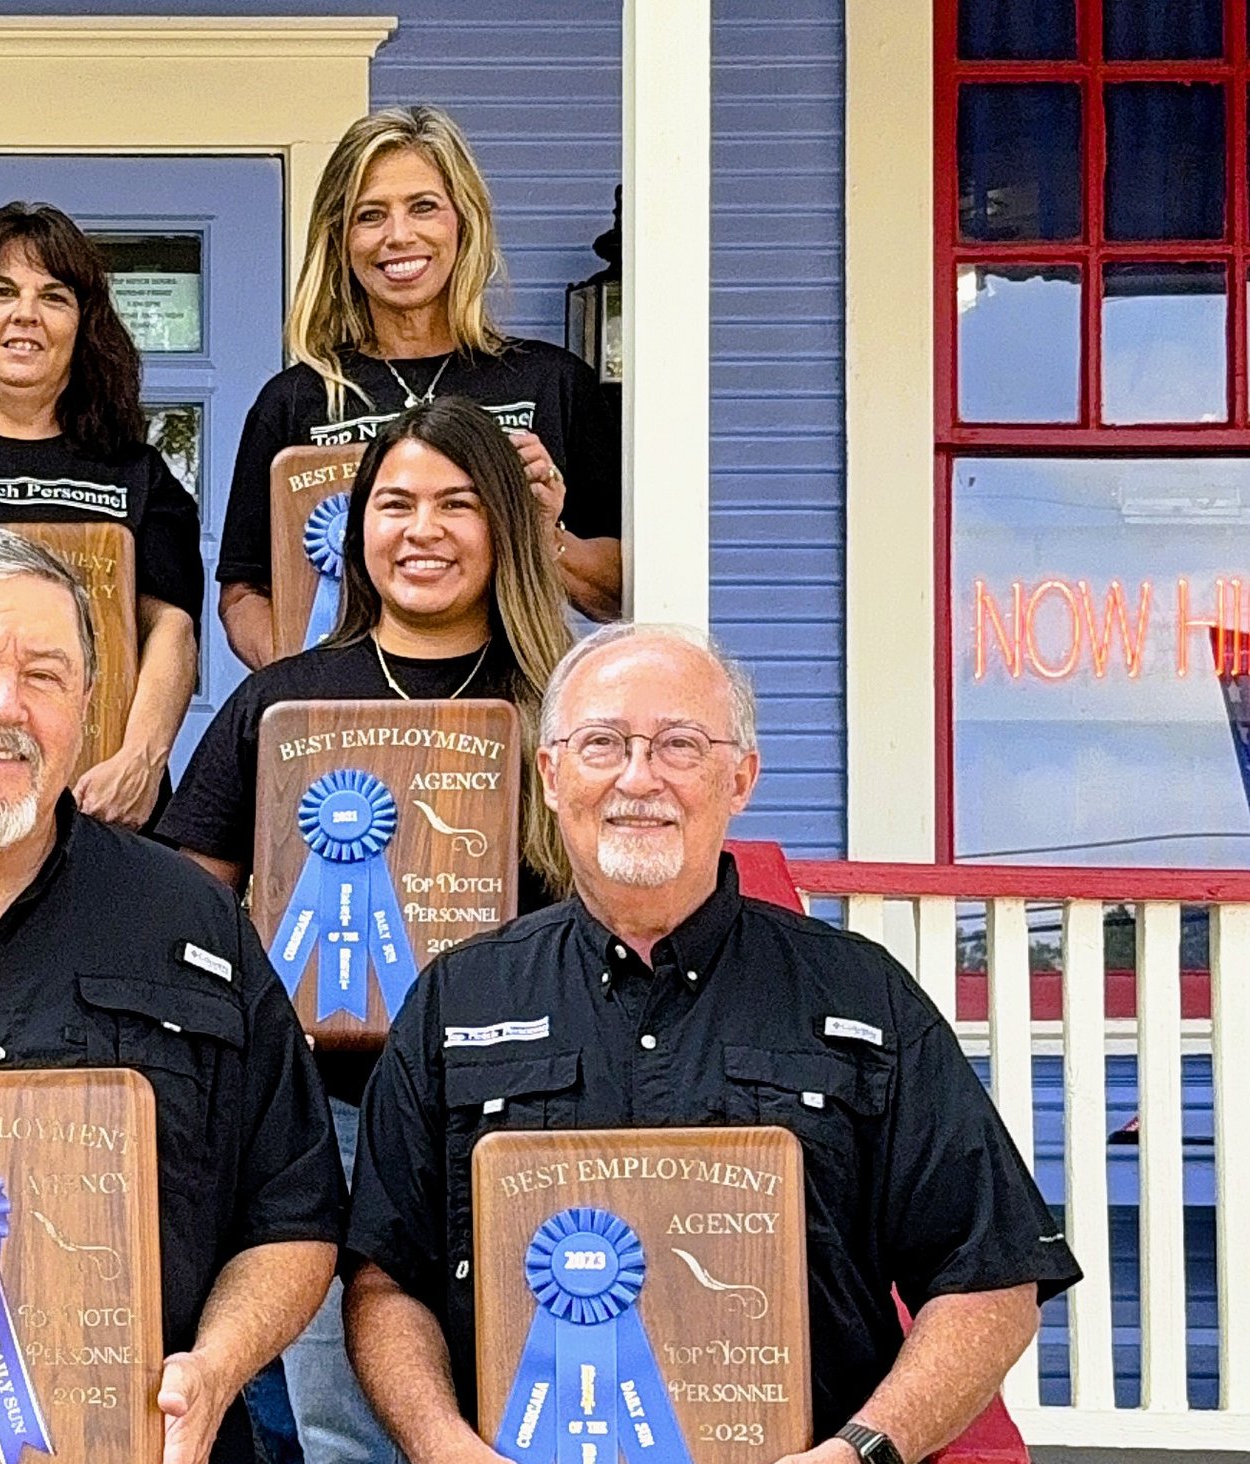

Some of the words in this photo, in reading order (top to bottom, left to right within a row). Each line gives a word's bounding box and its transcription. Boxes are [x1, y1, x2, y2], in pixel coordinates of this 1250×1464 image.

[288, 465, 338, 492] BEST
[27, 483, 127, 509] Personnel
[973, 579, 1151, 680] NOW
[1176, 579, 1250, 678] HI
[279, 732, 336, 761] BEST
[341, 728, 506, 760] EMPLOYMENT
[408, 772, 501, 790] AGENCY
[499, 1163, 570, 1199] BEST
[578, 1157, 783, 1197] EMPLOYMENT
[667, 1213, 780, 1235] AGENCY
[564, 1251, 607, 1271] 2023
[53, 1387, 118, 1409] 2025
[3, 1397, 27, 1436] SUN
[700, 1423, 764, 1446] 2023
